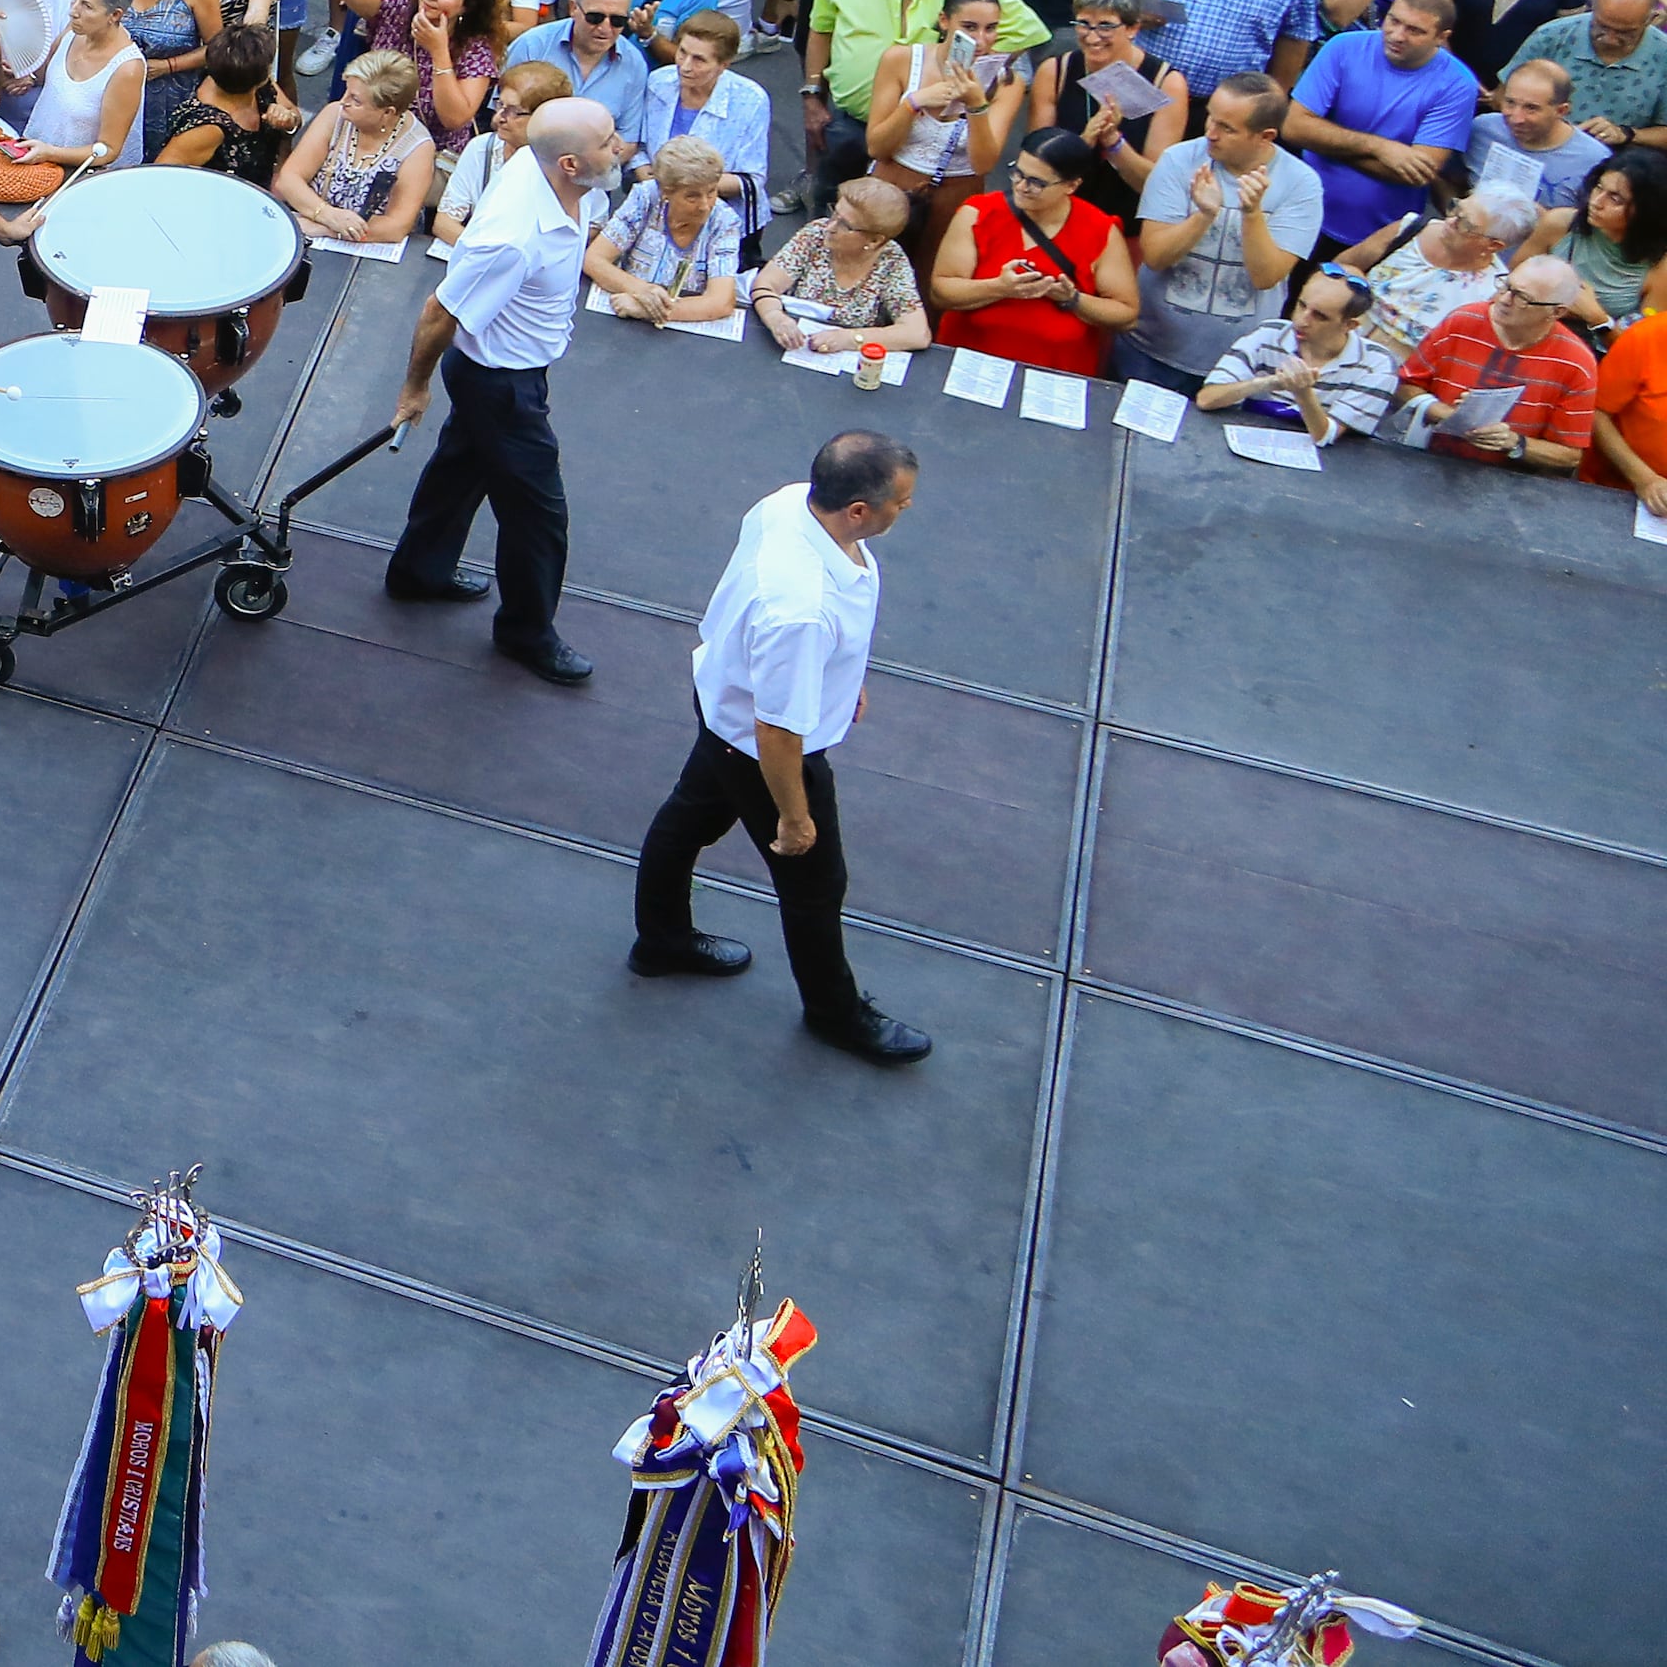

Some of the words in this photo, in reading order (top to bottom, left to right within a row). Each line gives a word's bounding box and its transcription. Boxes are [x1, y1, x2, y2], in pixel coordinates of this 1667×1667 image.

[129, 1420, 153, 1468] MOROS
[127, 1469, 145, 1479] I
[113, 1479, 145, 1553] CRISTIANS
[677, 1574, 714, 1644] Moros
